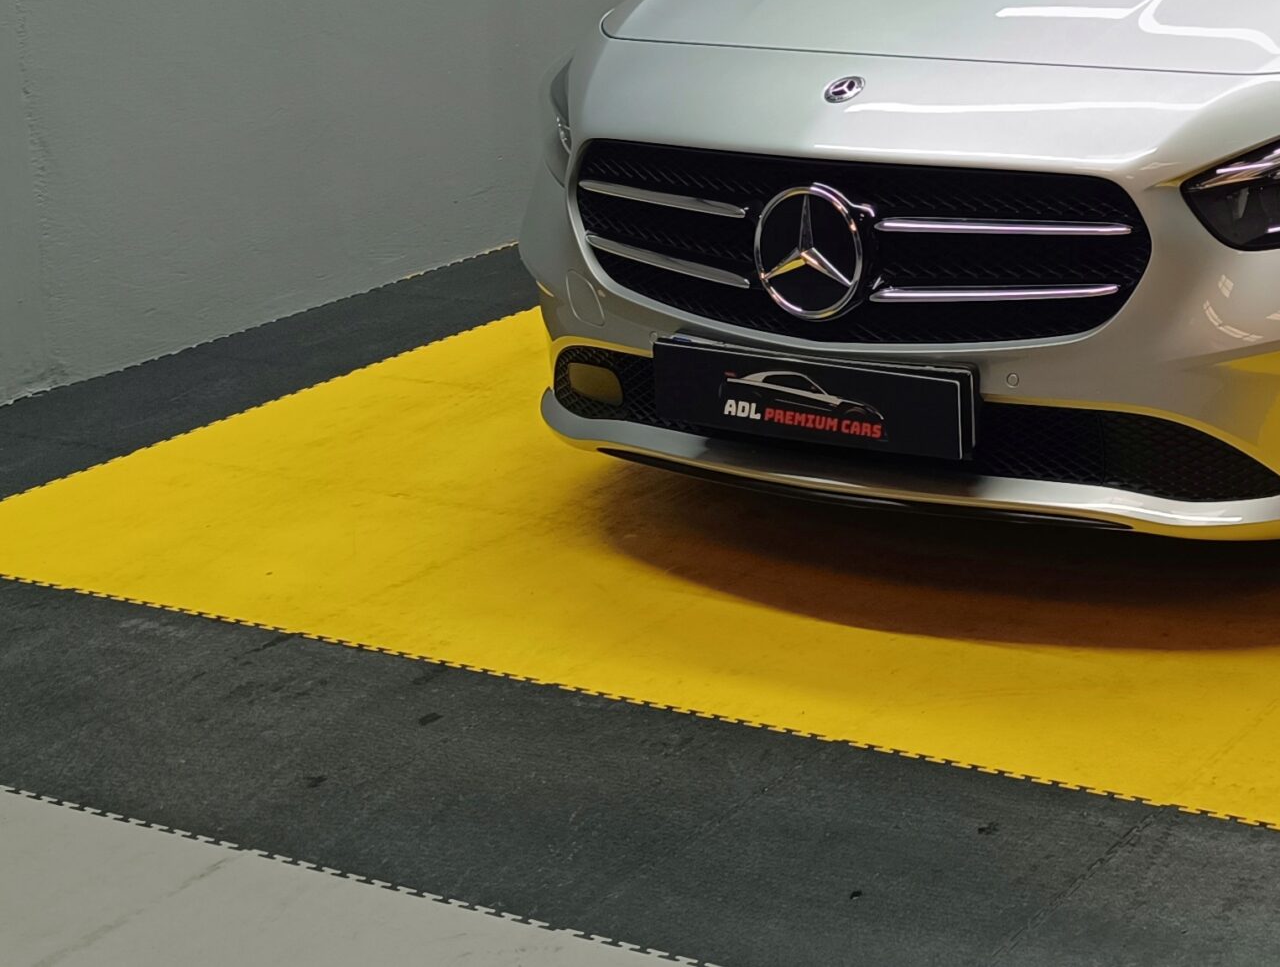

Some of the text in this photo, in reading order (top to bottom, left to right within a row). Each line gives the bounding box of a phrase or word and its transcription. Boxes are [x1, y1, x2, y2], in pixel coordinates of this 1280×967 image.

[724, 399, 882, 439] ADL PREMIUM CARS
